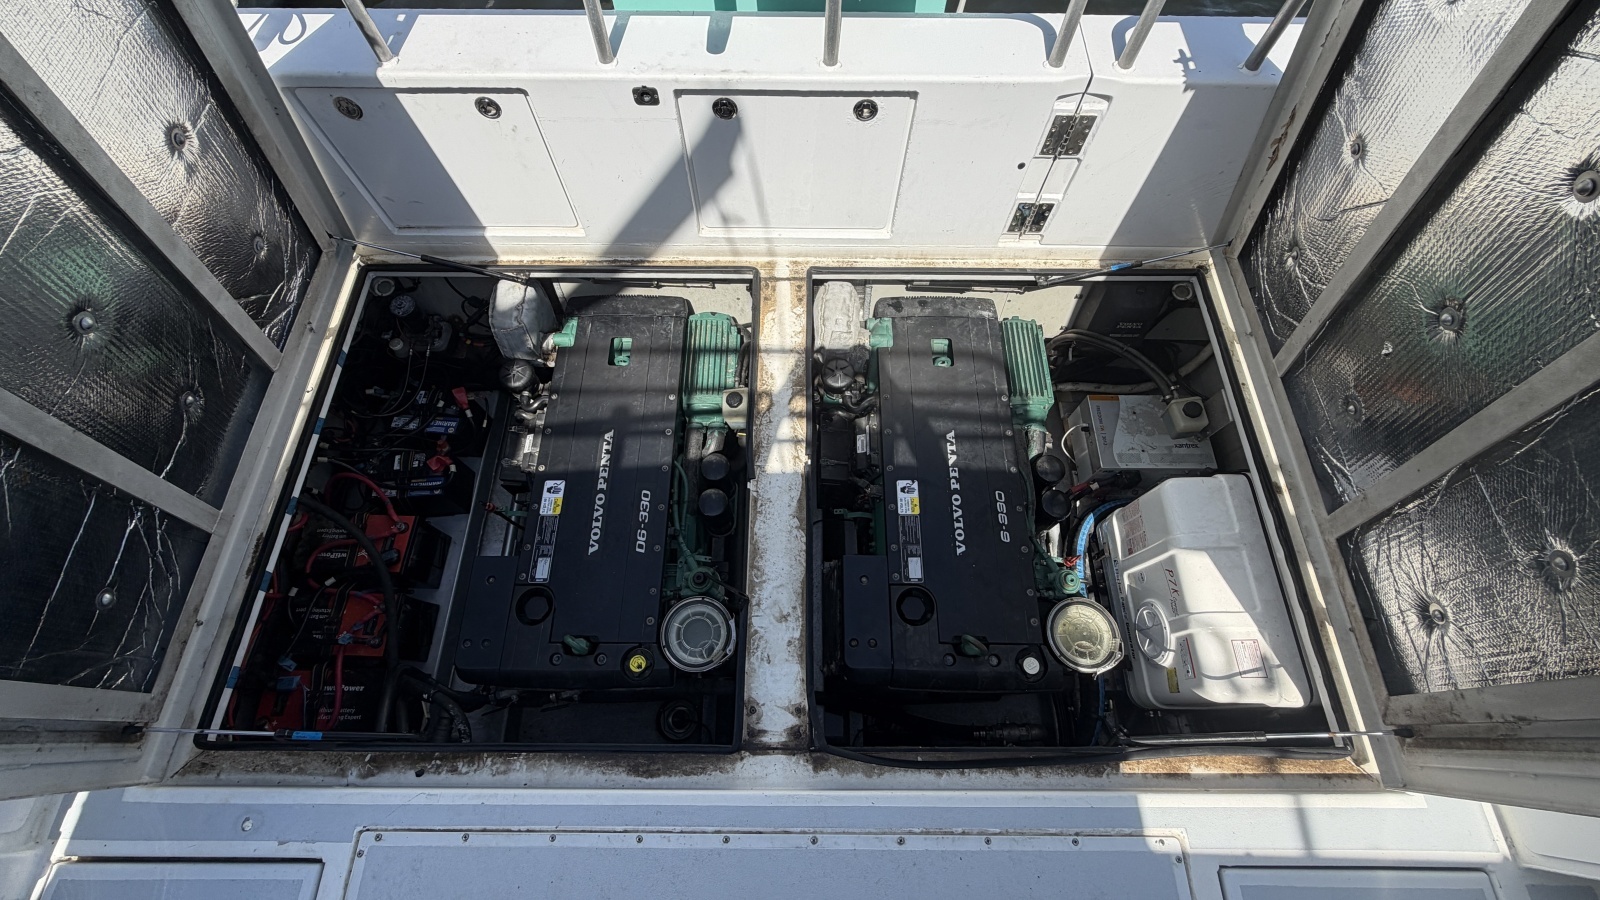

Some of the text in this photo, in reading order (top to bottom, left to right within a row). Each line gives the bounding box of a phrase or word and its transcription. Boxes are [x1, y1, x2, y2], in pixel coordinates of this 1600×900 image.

[588, 429, 615, 556] VOLVO PENTA
[635, 489, 651, 554] D6-330
[945, 429, 967, 556] VOLVO PENTA
[1126, 622, 1136, 660] Generator
